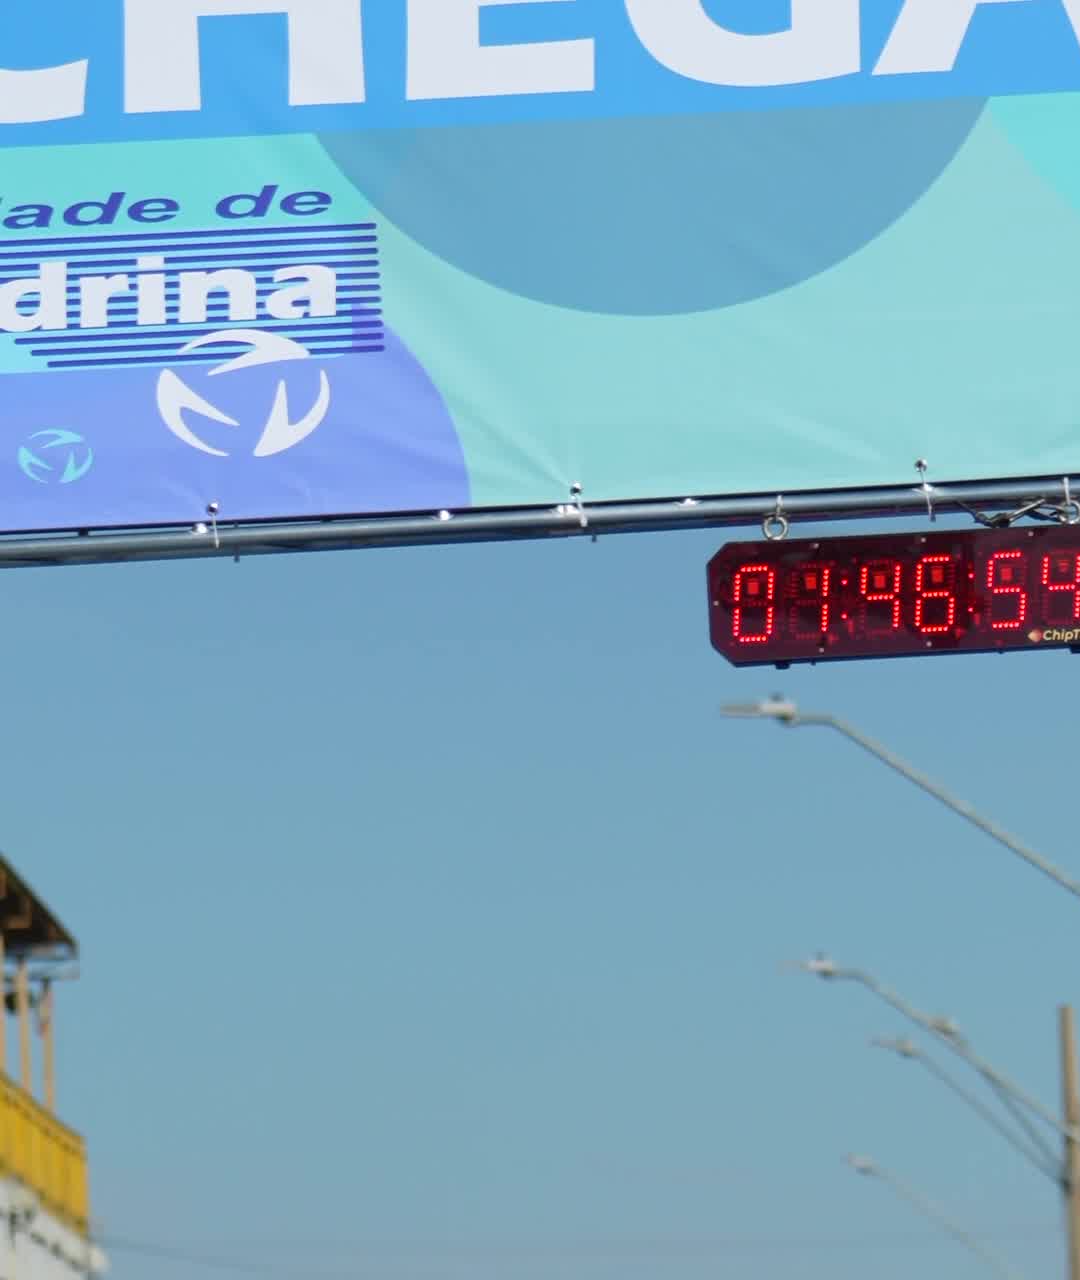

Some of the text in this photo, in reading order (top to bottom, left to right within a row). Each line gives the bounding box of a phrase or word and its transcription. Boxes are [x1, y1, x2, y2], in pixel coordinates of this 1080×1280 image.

[0, 185, 333, 229] ade de
[0, 256, 337, 332] drina
